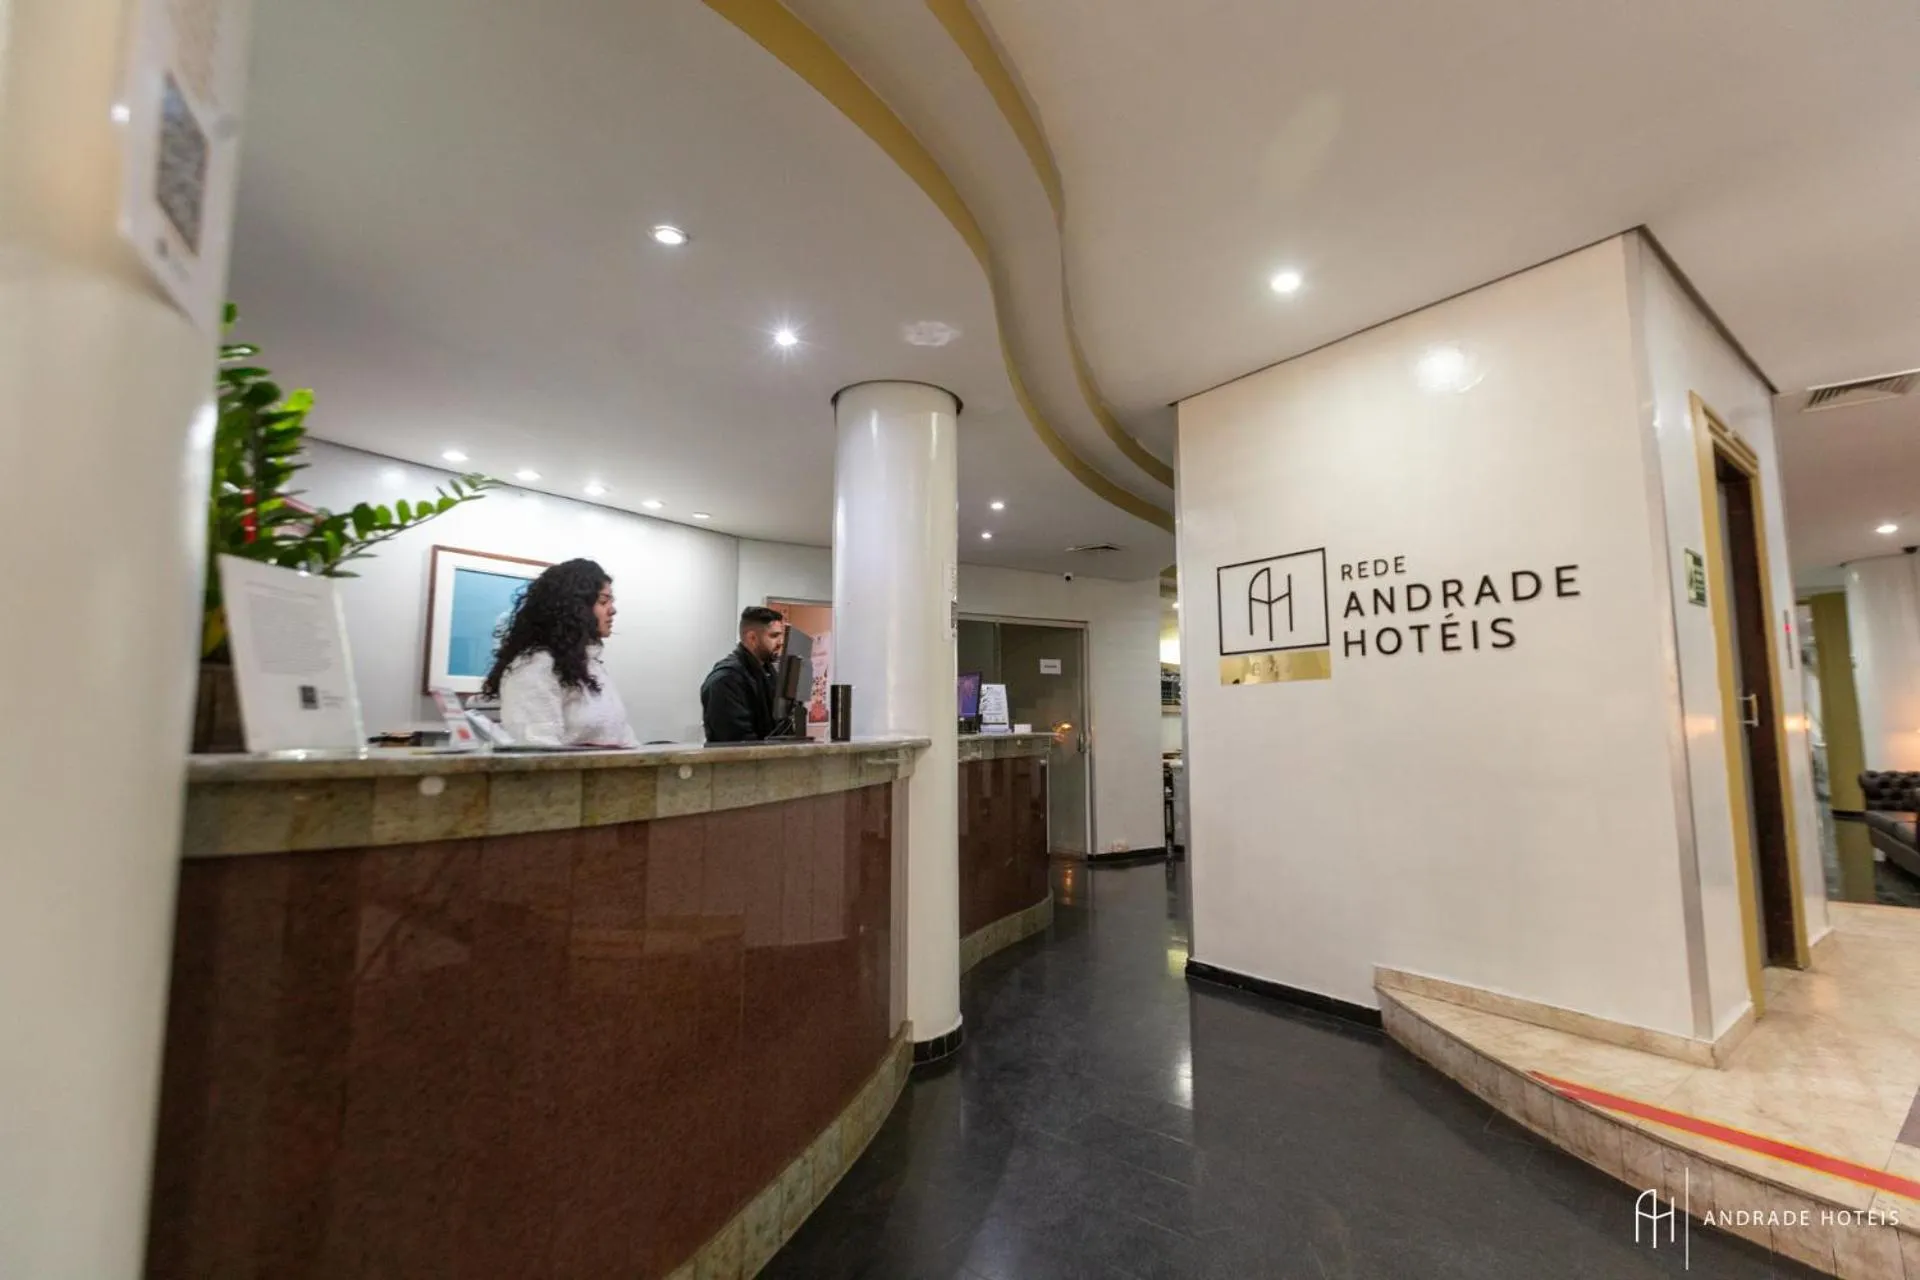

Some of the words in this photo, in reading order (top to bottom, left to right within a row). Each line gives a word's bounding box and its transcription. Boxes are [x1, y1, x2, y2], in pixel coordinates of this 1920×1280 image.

[1340, 555, 1407, 582] REDE
[1342, 563, 1581, 619] ANDRADE
[1342, 612, 1517, 658] HOTÉIS
